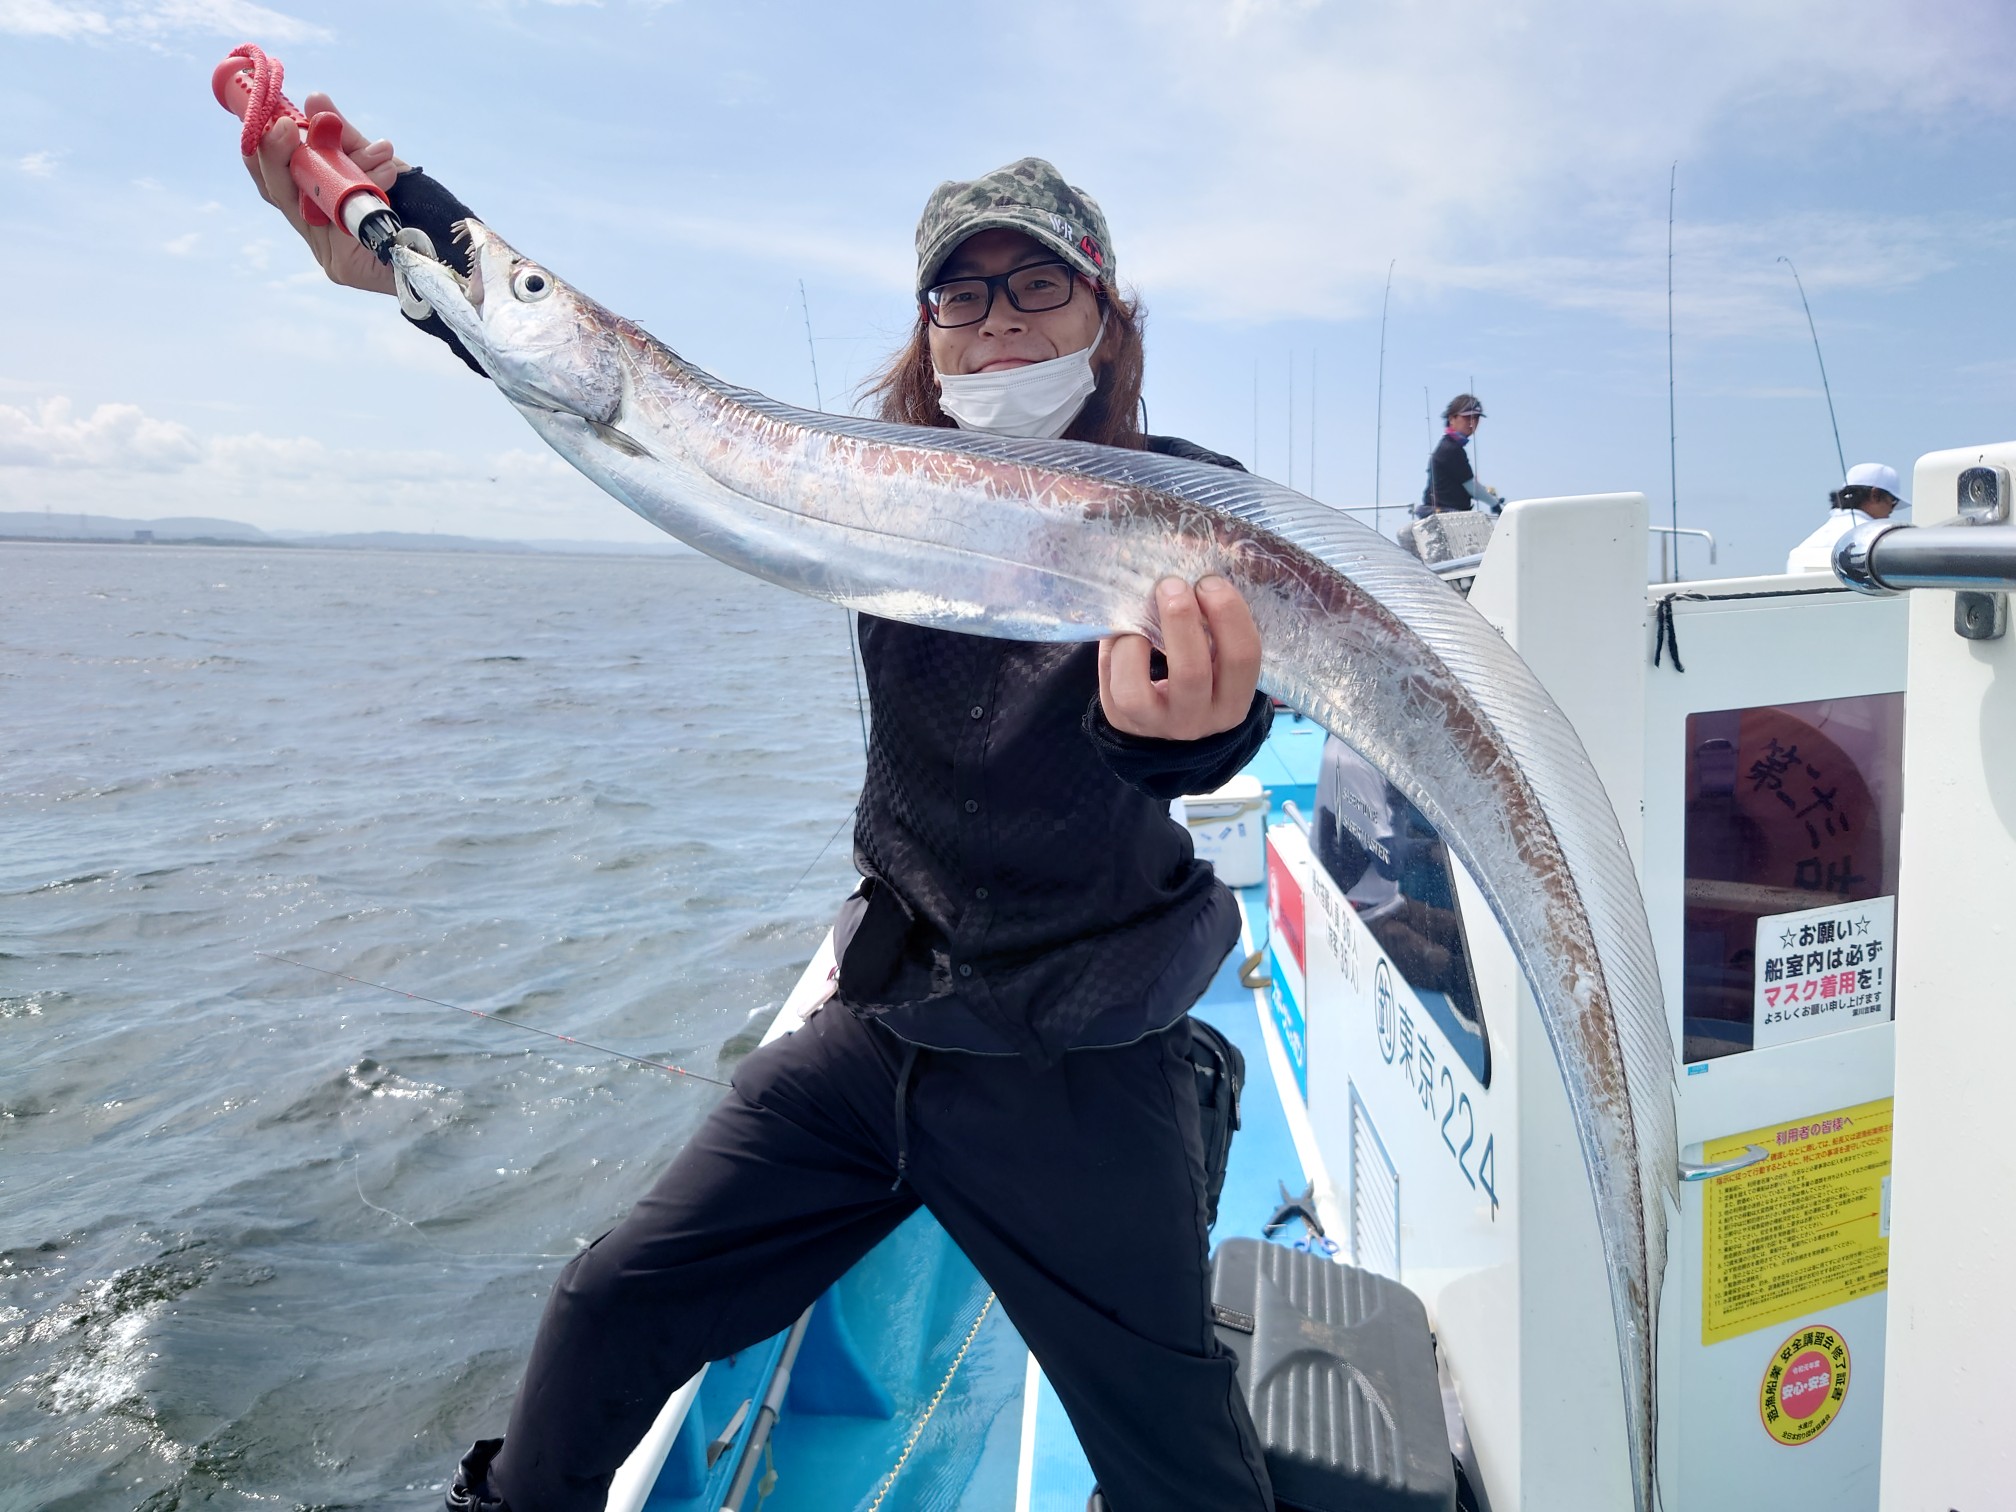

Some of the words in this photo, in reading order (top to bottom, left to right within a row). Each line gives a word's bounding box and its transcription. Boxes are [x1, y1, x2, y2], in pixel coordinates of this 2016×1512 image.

[1764, 940, 1883, 983] 船室内は必ず
[1764, 991, 1882, 1025] よろしくお願い申し上げます
[1776, 1116, 1854, 1146] 利用者の皆様へ
